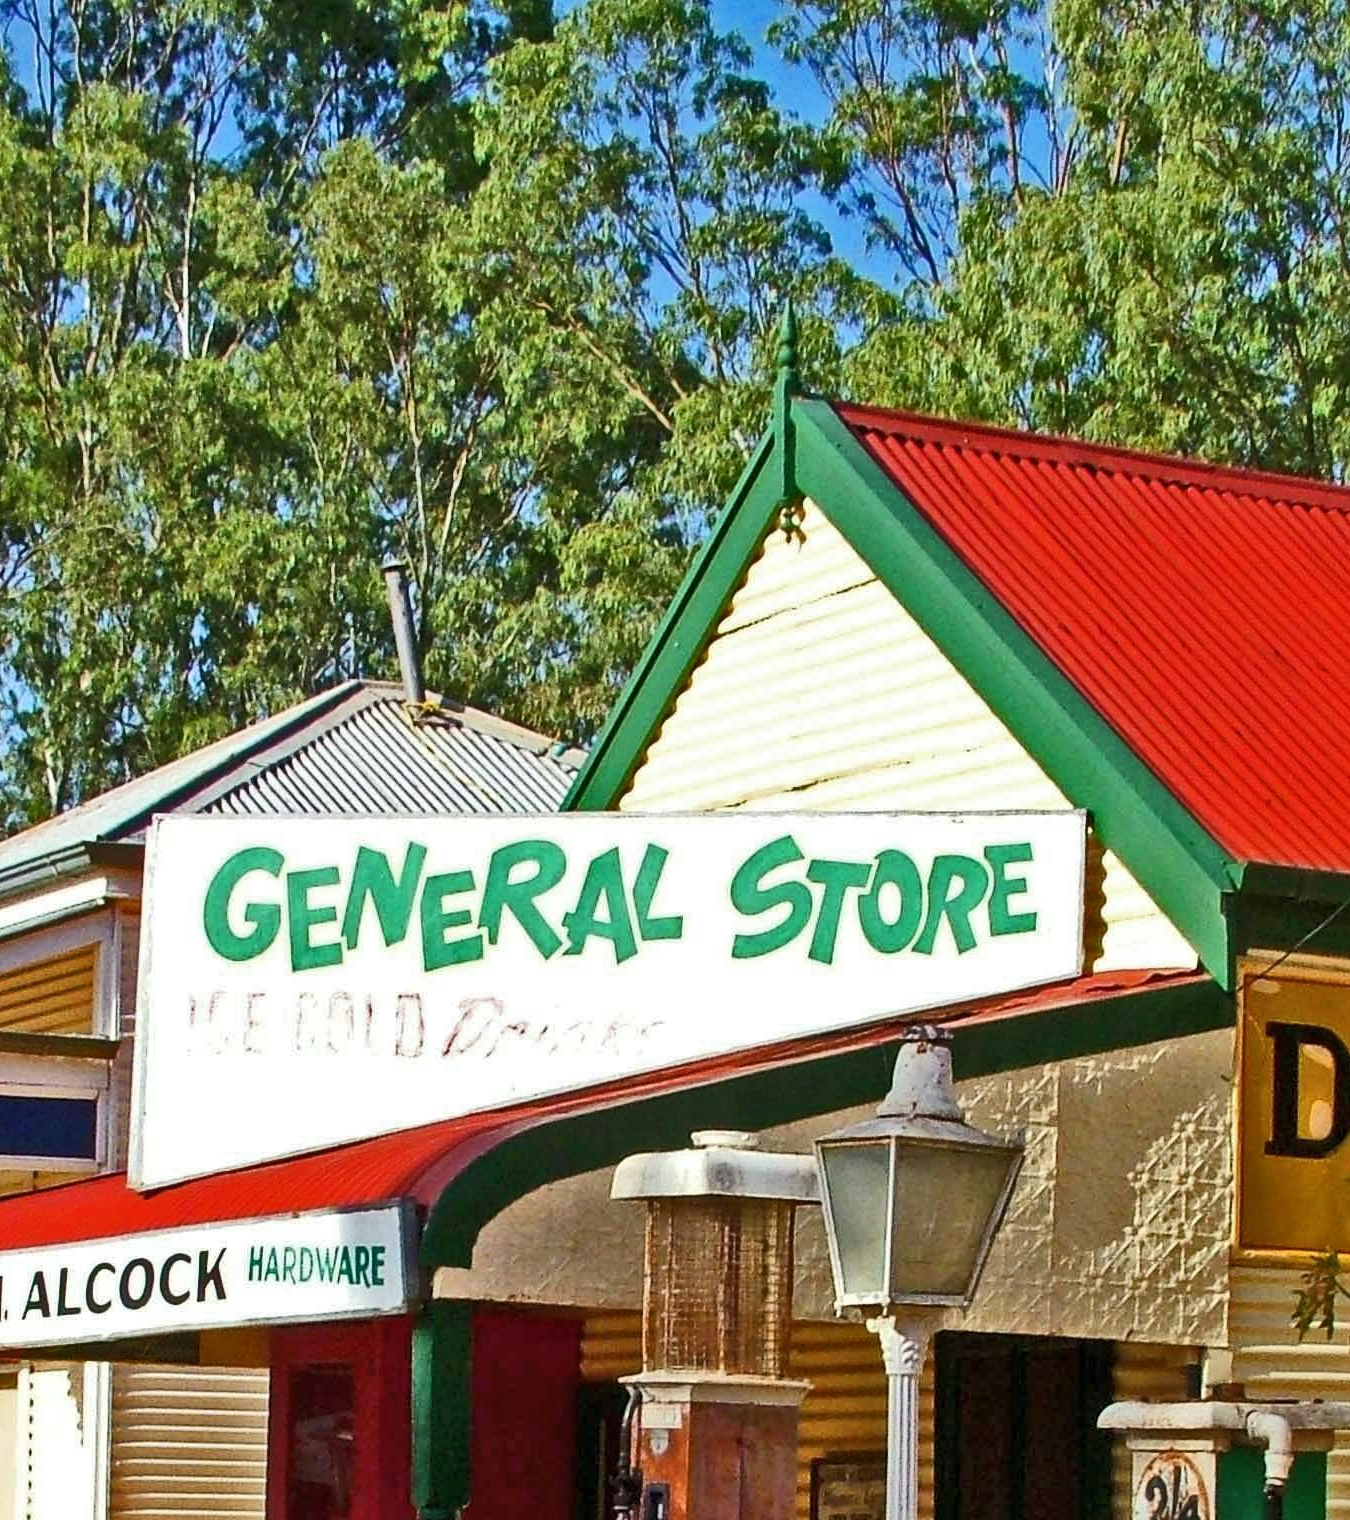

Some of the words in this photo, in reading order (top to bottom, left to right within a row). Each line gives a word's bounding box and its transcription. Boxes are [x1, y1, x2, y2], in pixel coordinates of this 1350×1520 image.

[203, 839, 683, 972] GENERAL
[730, 834, 1038, 965] STORE
[22, 1247, 228, 1321] ALCOCK
[248, 1246, 386, 1288] HARDWARE
